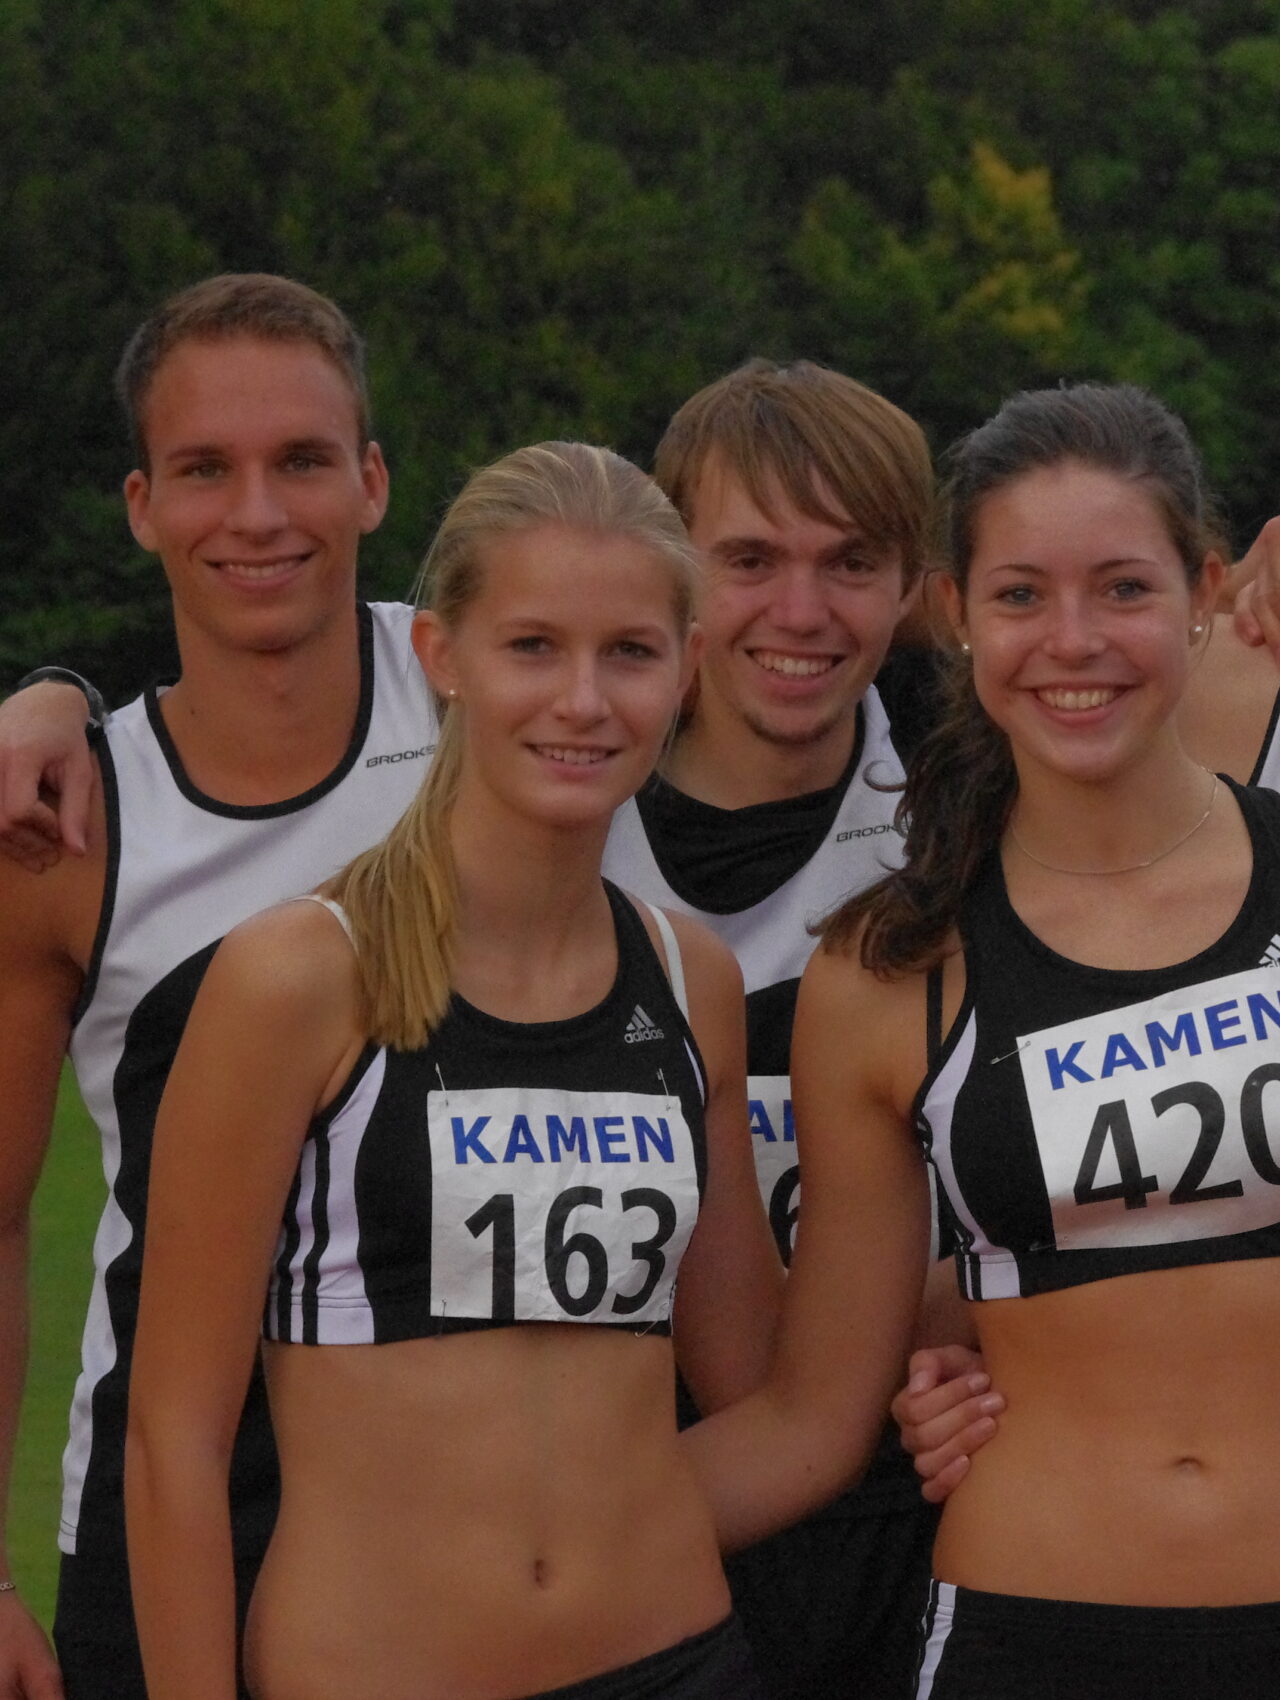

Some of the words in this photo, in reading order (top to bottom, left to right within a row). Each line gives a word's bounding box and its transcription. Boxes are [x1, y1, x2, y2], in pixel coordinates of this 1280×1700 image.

[624, 1026, 665, 1044] adidas
[450, 1114, 675, 1165] KAMEN
[464, 1185, 677, 1321] 163
